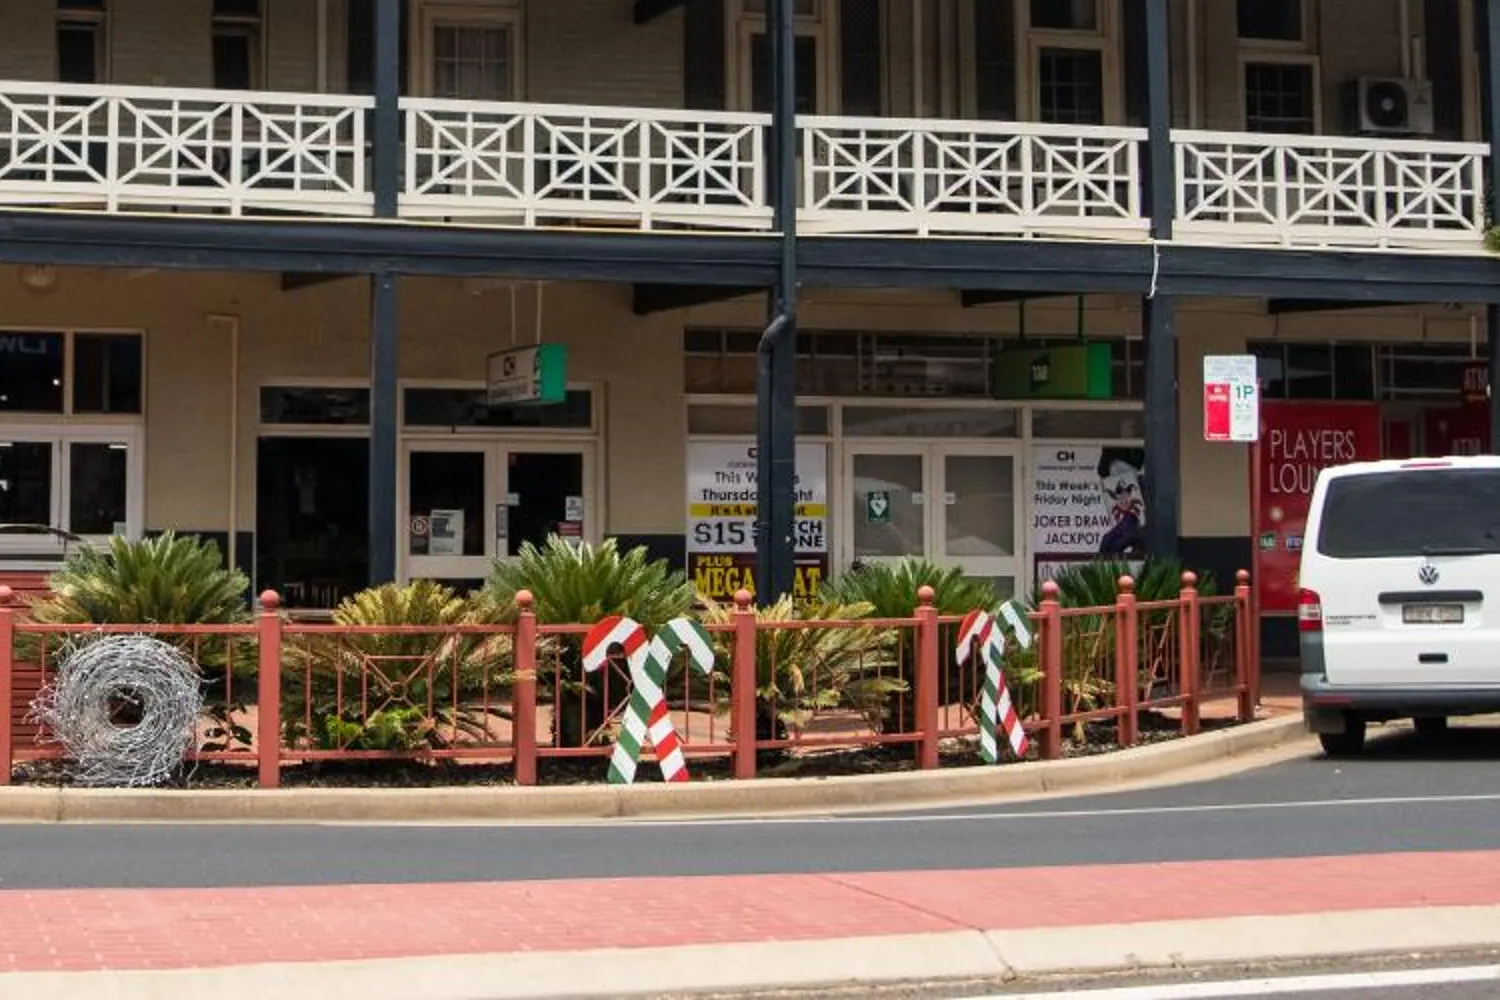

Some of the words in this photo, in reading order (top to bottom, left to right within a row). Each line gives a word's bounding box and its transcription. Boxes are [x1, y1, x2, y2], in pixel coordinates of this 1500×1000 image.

[1235, 384, 1255, 401] 1P
[1269, 429, 1357, 460] PLAYERS
[714, 471, 742, 484] This
[1035, 479, 1056, 491] This
[701, 488, 759, 502] Thursda
[1034, 493, 1069, 506] Friday
[1071, 493, 1101, 507] Night
[1033, 515, 1071, 529] JOKER
[1075, 515, 1111, 528] DRAW
[1043, 531, 1101, 545] JACKPOT
[697, 555, 733, 567] PLUS
[694, 567, 757, 597] MEGA
